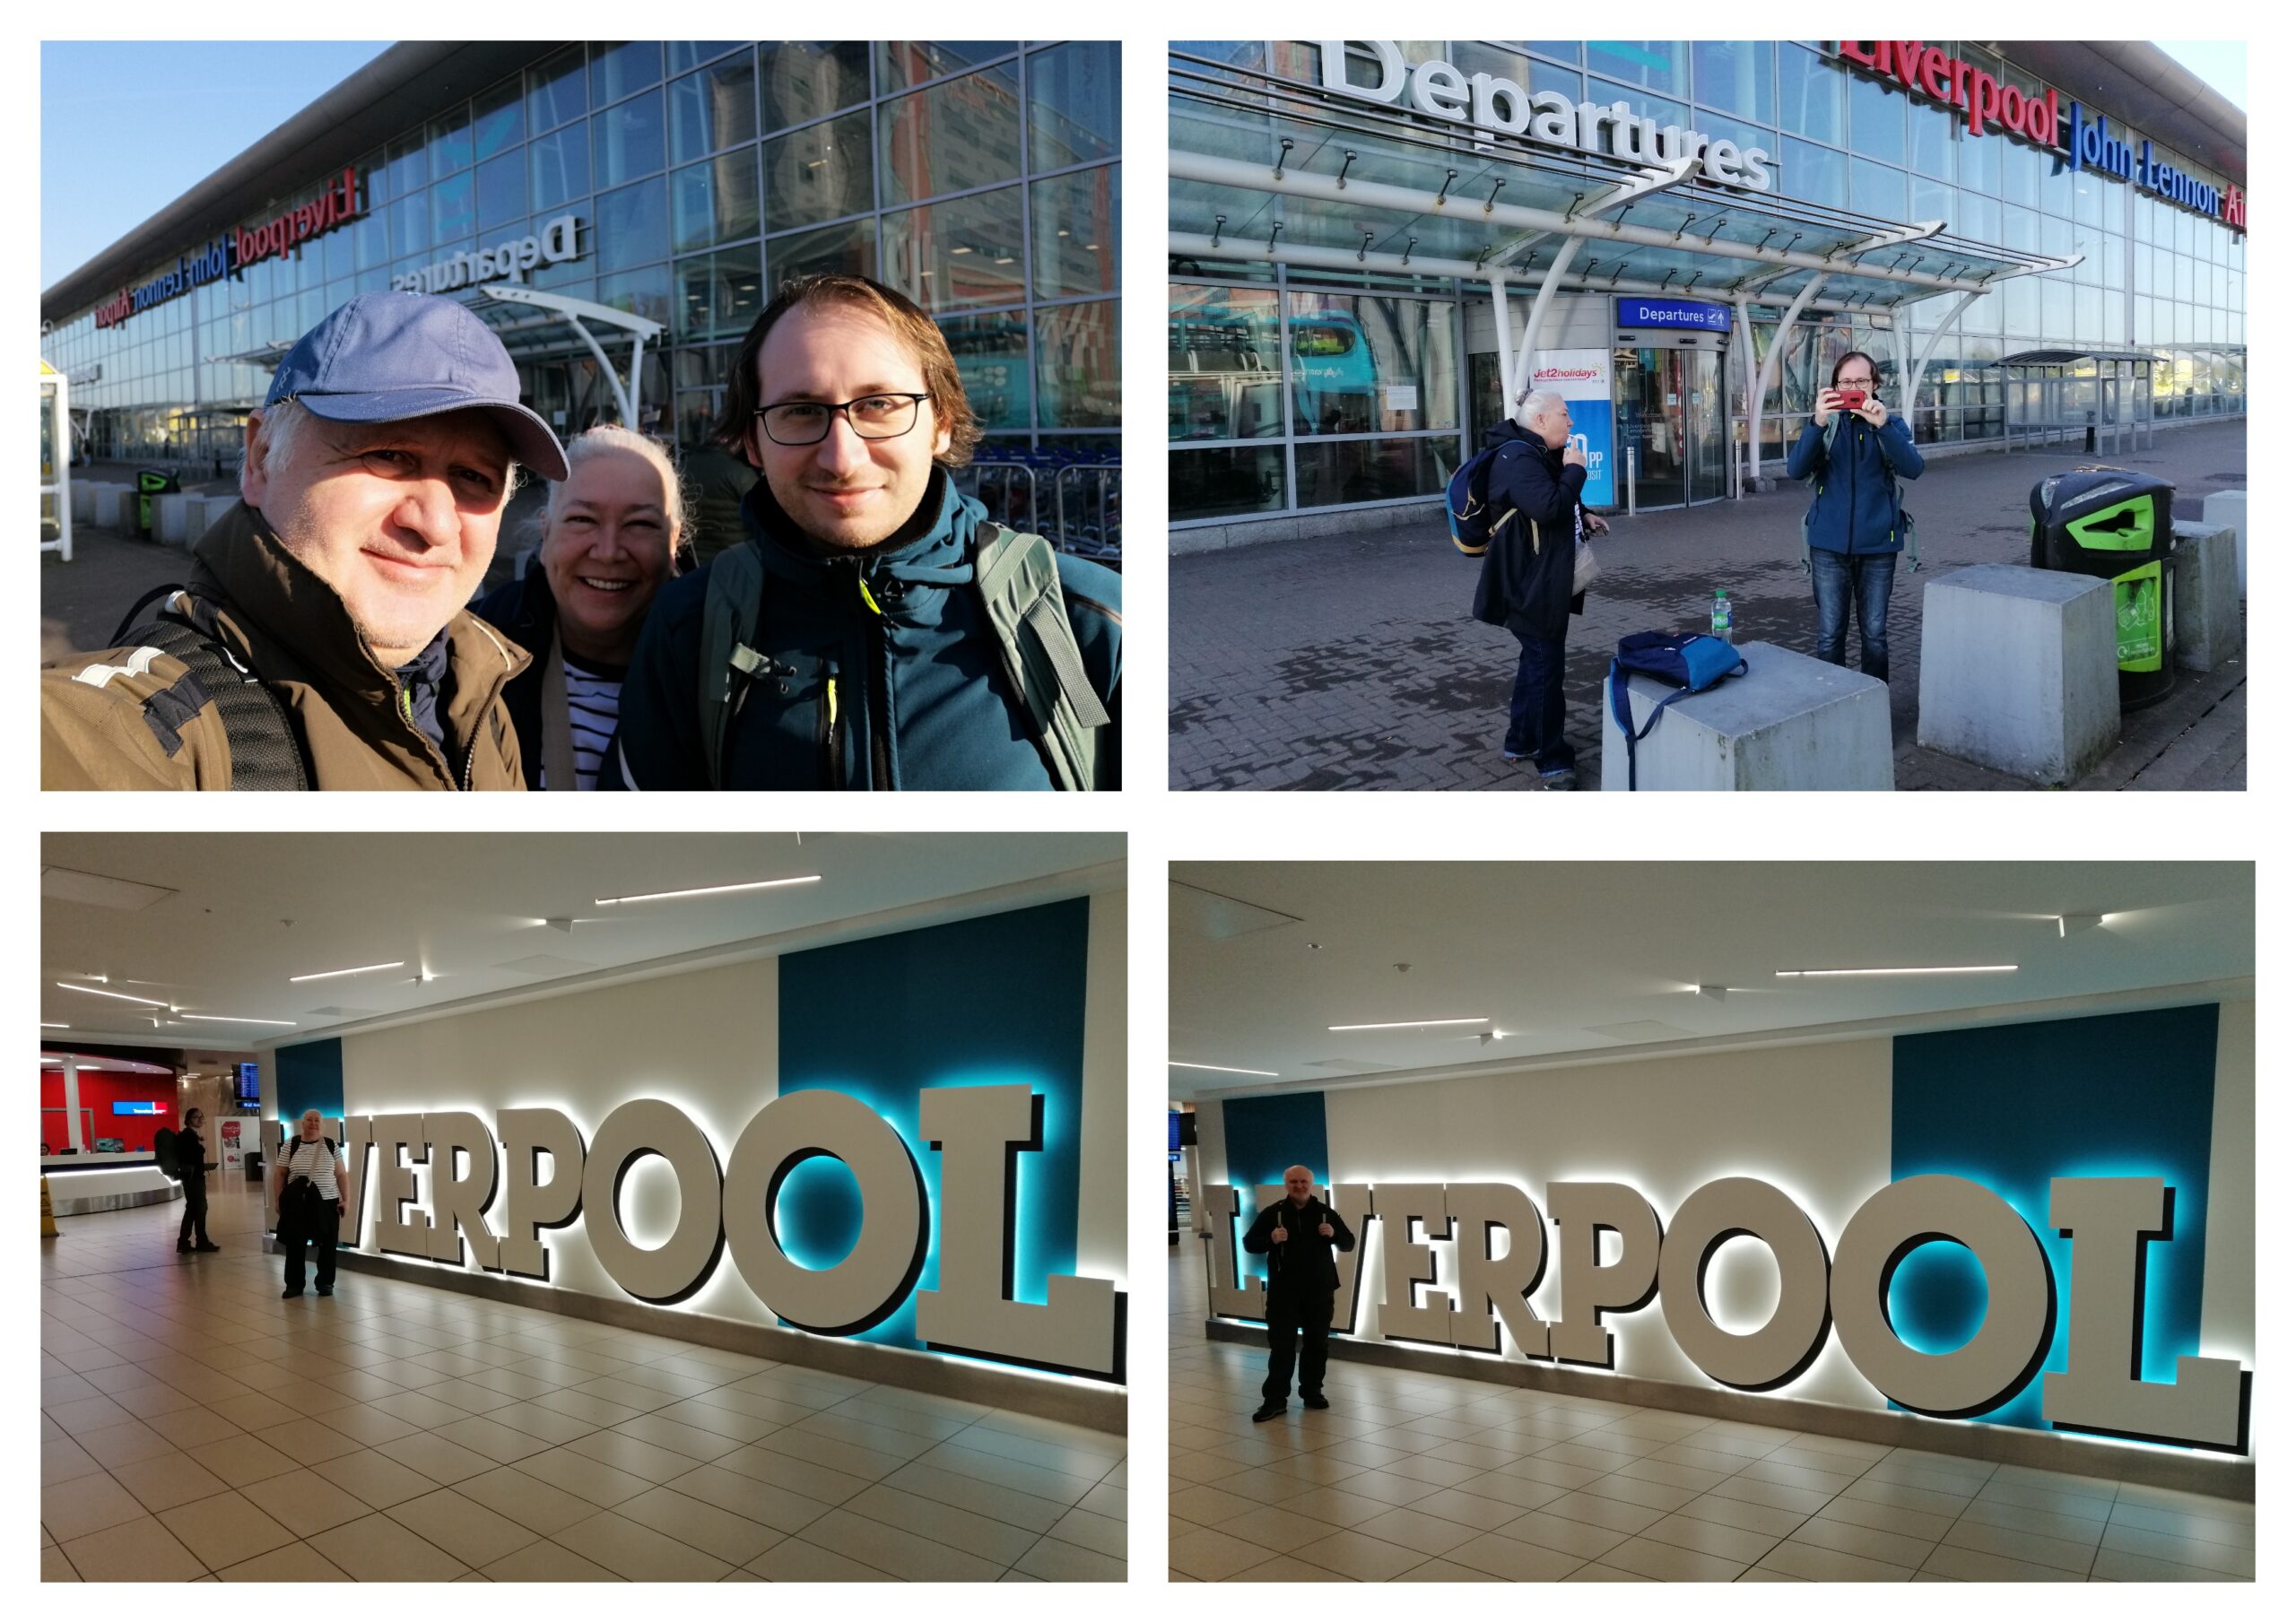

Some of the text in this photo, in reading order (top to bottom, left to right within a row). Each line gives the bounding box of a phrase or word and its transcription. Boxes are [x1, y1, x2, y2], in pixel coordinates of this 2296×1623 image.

[1323, 40, 1771, 190] Departures
[2069, 100, 2135, 179] John
[2143, 139, 2221, 216] Lennon
[2222, 183, 2248, 231] Ai
[1639, 307, 1704, 323] Departures
[1588, 451, 1604, 469] PP
